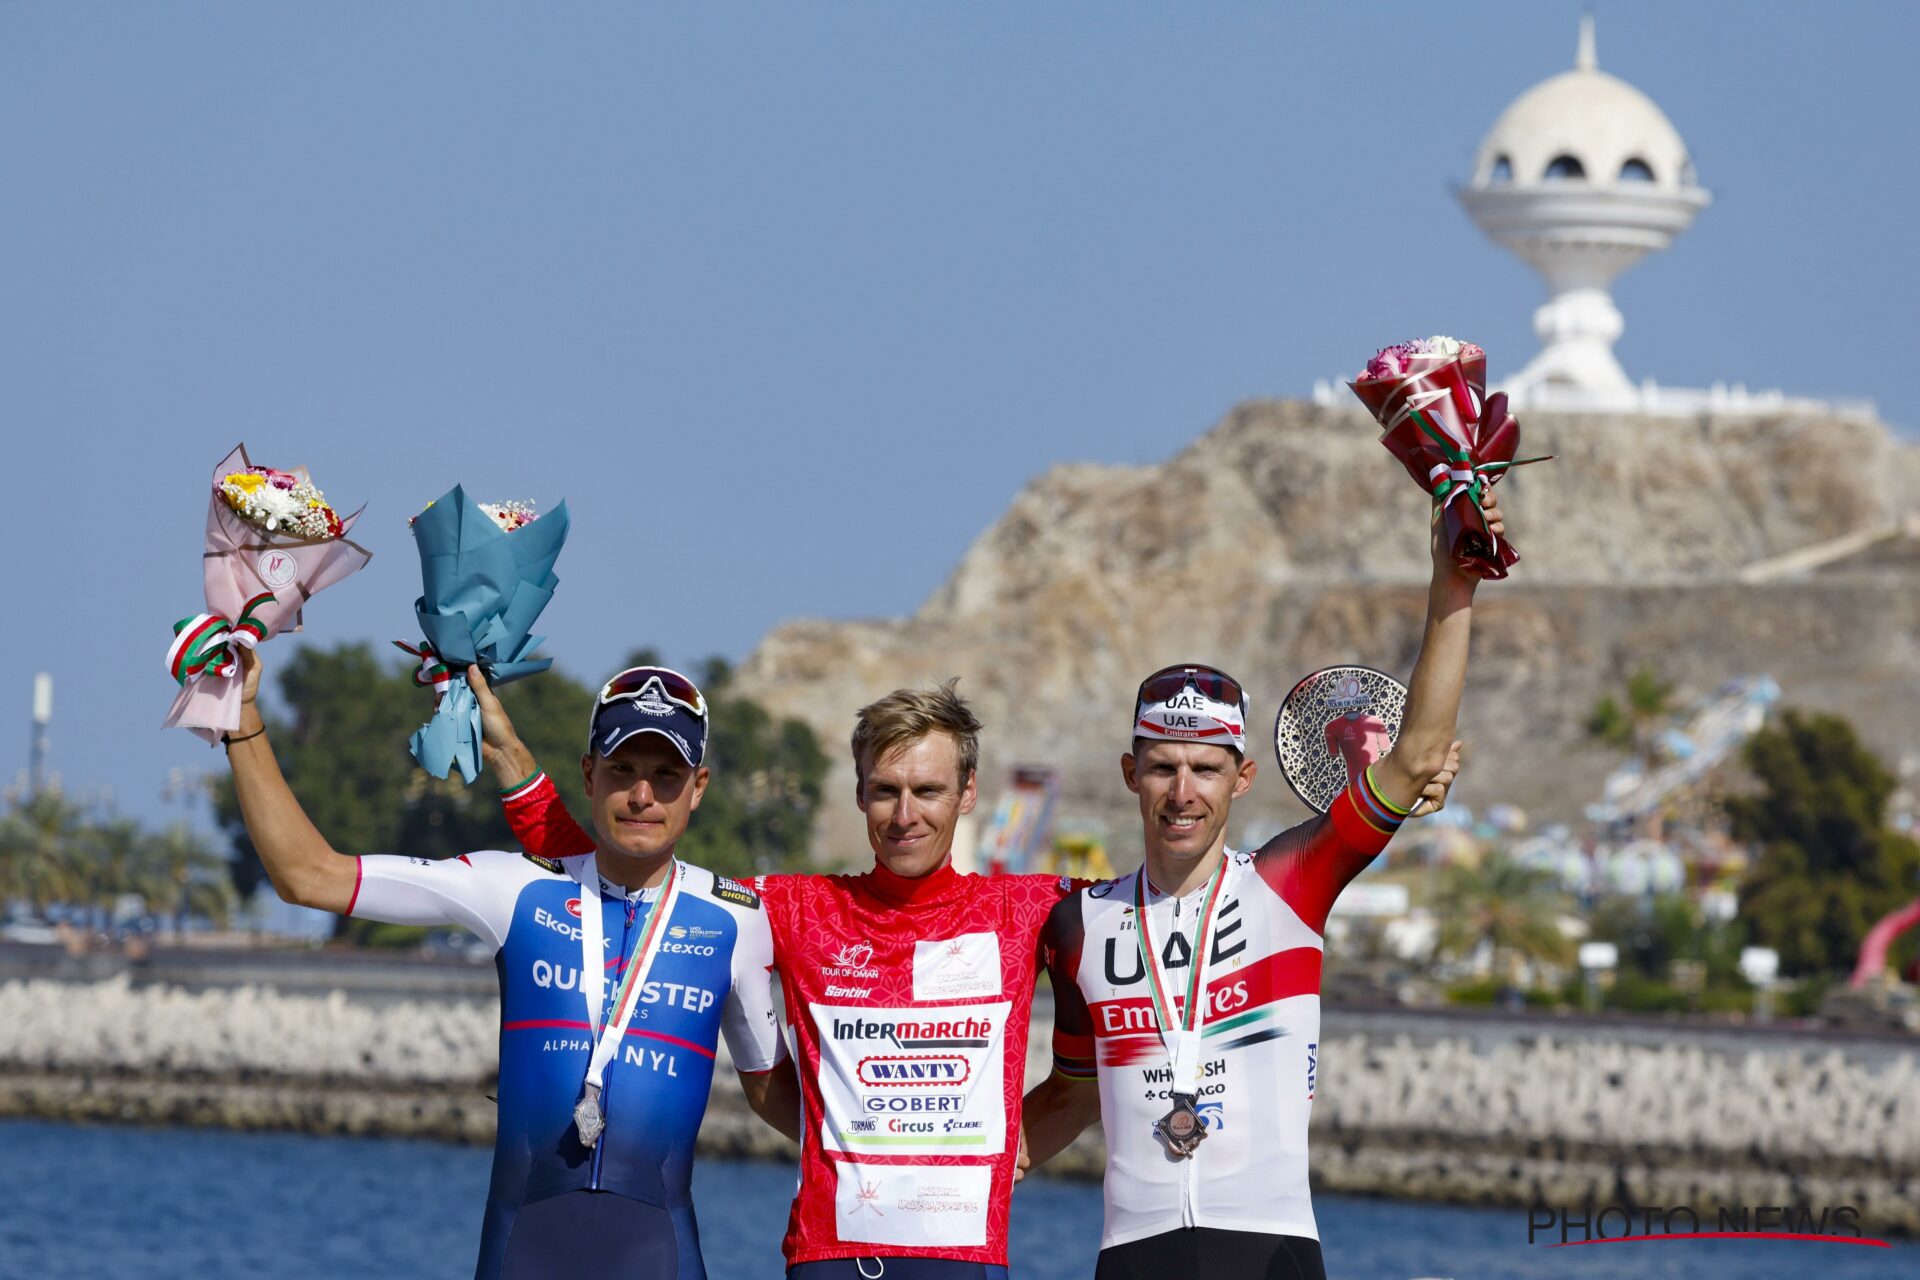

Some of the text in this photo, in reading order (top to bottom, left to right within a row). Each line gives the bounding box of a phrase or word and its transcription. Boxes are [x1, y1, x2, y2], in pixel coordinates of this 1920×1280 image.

[1165, 696, 1204, 710] UAE
[1163, 714, 1198, 728] UAE
[1164, 728, 1199, 738] Emirates
[721, 890, 753, 904] SHOES
[534, 907, 612, 949] Ekopk
[822, 967, 879, 979] TOUR OF OMAN
[824, 985, 872, 999] Santini
[543, 1039, 590, 1052] ALPHA
[870, 1063, 959, 1079] WANTY
[1307, 1043, 1317, 1092] FAB
[1158, 1083, 1226, 1100] COAGO
[866, 1096, 962, 1113] GOBERT
[851, 1119, 876, 1132] TORMANS
[888, 1118, 934, 1133] Circus
[952, 1121, 983, 1129] CUBE
